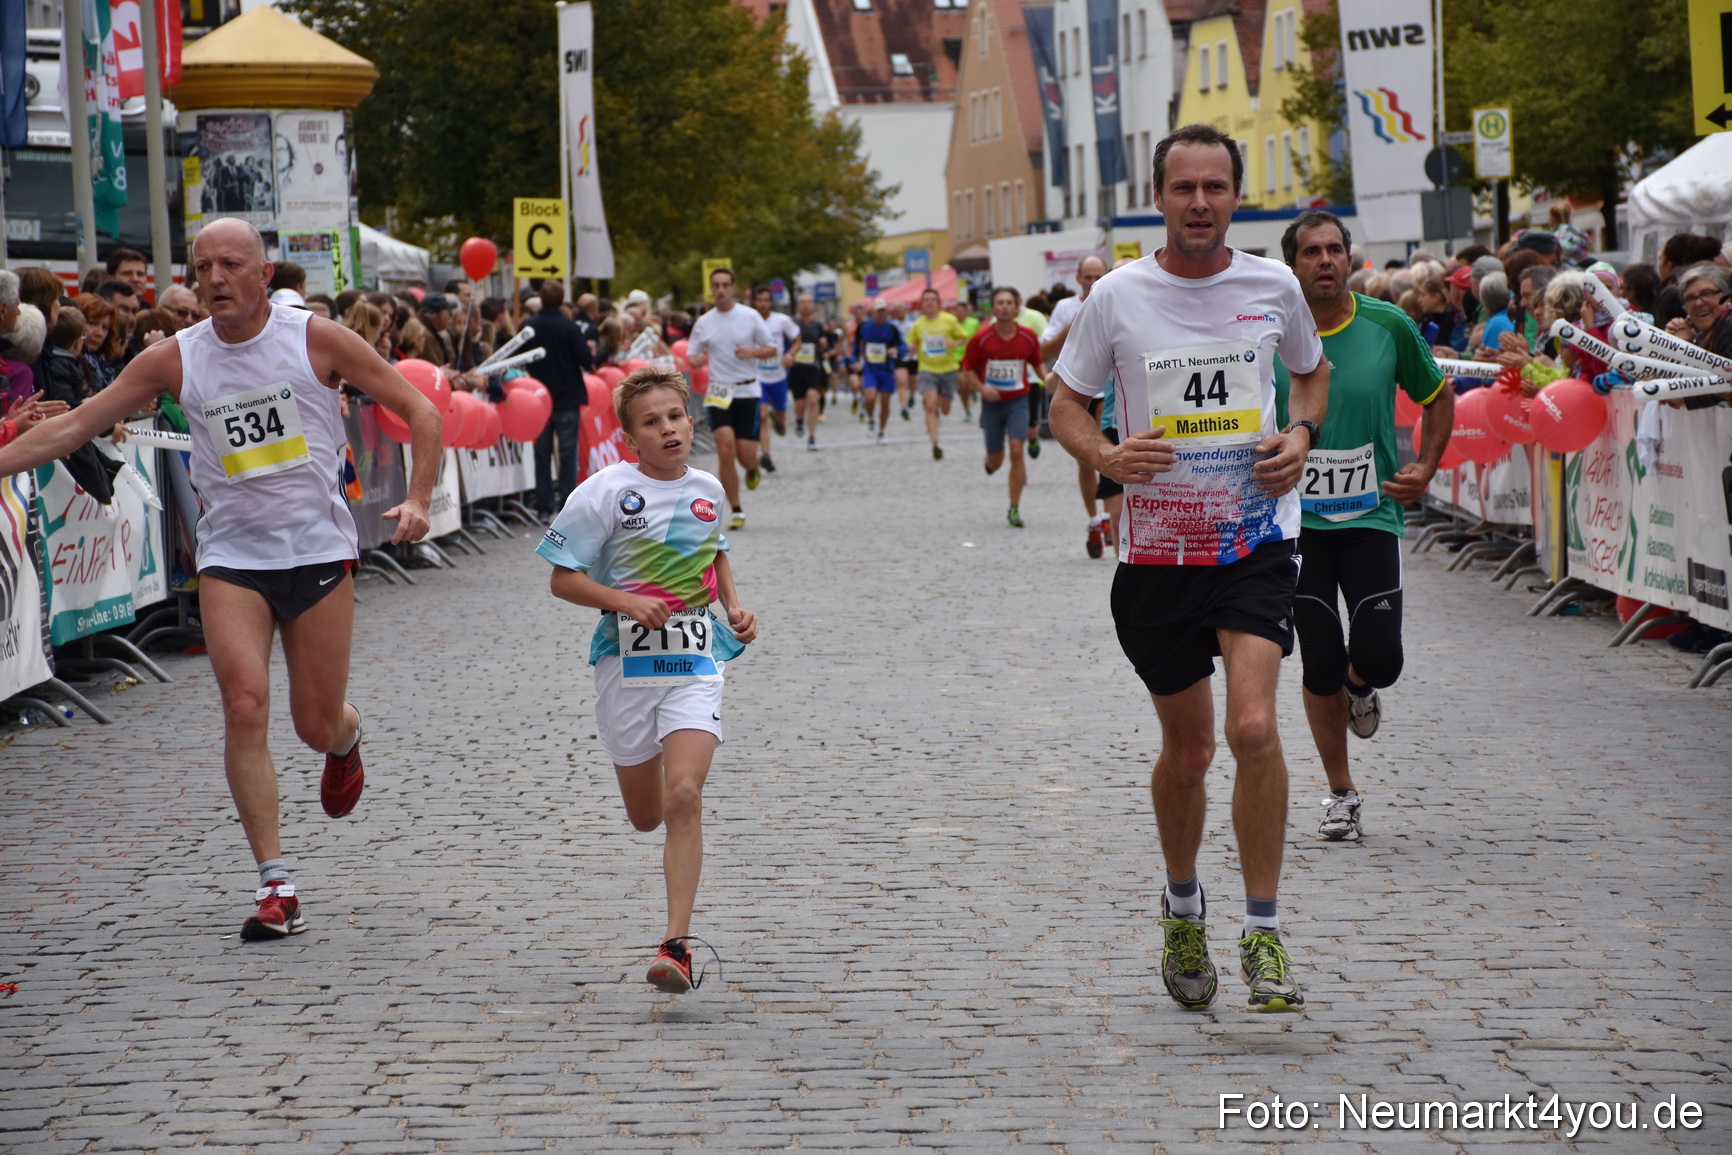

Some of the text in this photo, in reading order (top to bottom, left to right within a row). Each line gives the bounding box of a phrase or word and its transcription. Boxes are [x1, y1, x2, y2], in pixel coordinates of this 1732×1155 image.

[520, 202, 561, 217] Block
[527, 223, 553, 260] C
[1236, 314, 1276, 322] CeramTec
[1578, 335, 1610, 359] BMW
[1649, 332, 1732, 370] bmw-laufspo
[1149, 354, 1240, 371] PARTL Neumarkt
[1457, 365, 1499, 377] Laufsp
[1641, 365, 1677, 379] BMW
[1183, 369, 1229, 408] 44
[1668, 377, 1704, 391] BMW
[204, 394, 278, 419] PARTL Neumarkt
[224, 406, 285, 448] 534
[1176, 416, 1239, 435] Matthias
[1305, 455, 1363, 465] ARTL Neumarkt
[1305, 463, 1370, 495] 2177
[1158, 488, 1230, 498] Technische Keramik
[1132, 495, 1204, 514] Experten
[1314, 500, 1362, 513] Christian
[1161, 518, 1213, 529] Pioneers
[631, 620, 707, 652] 2119
[653, 659, 694, 673] Moritz
